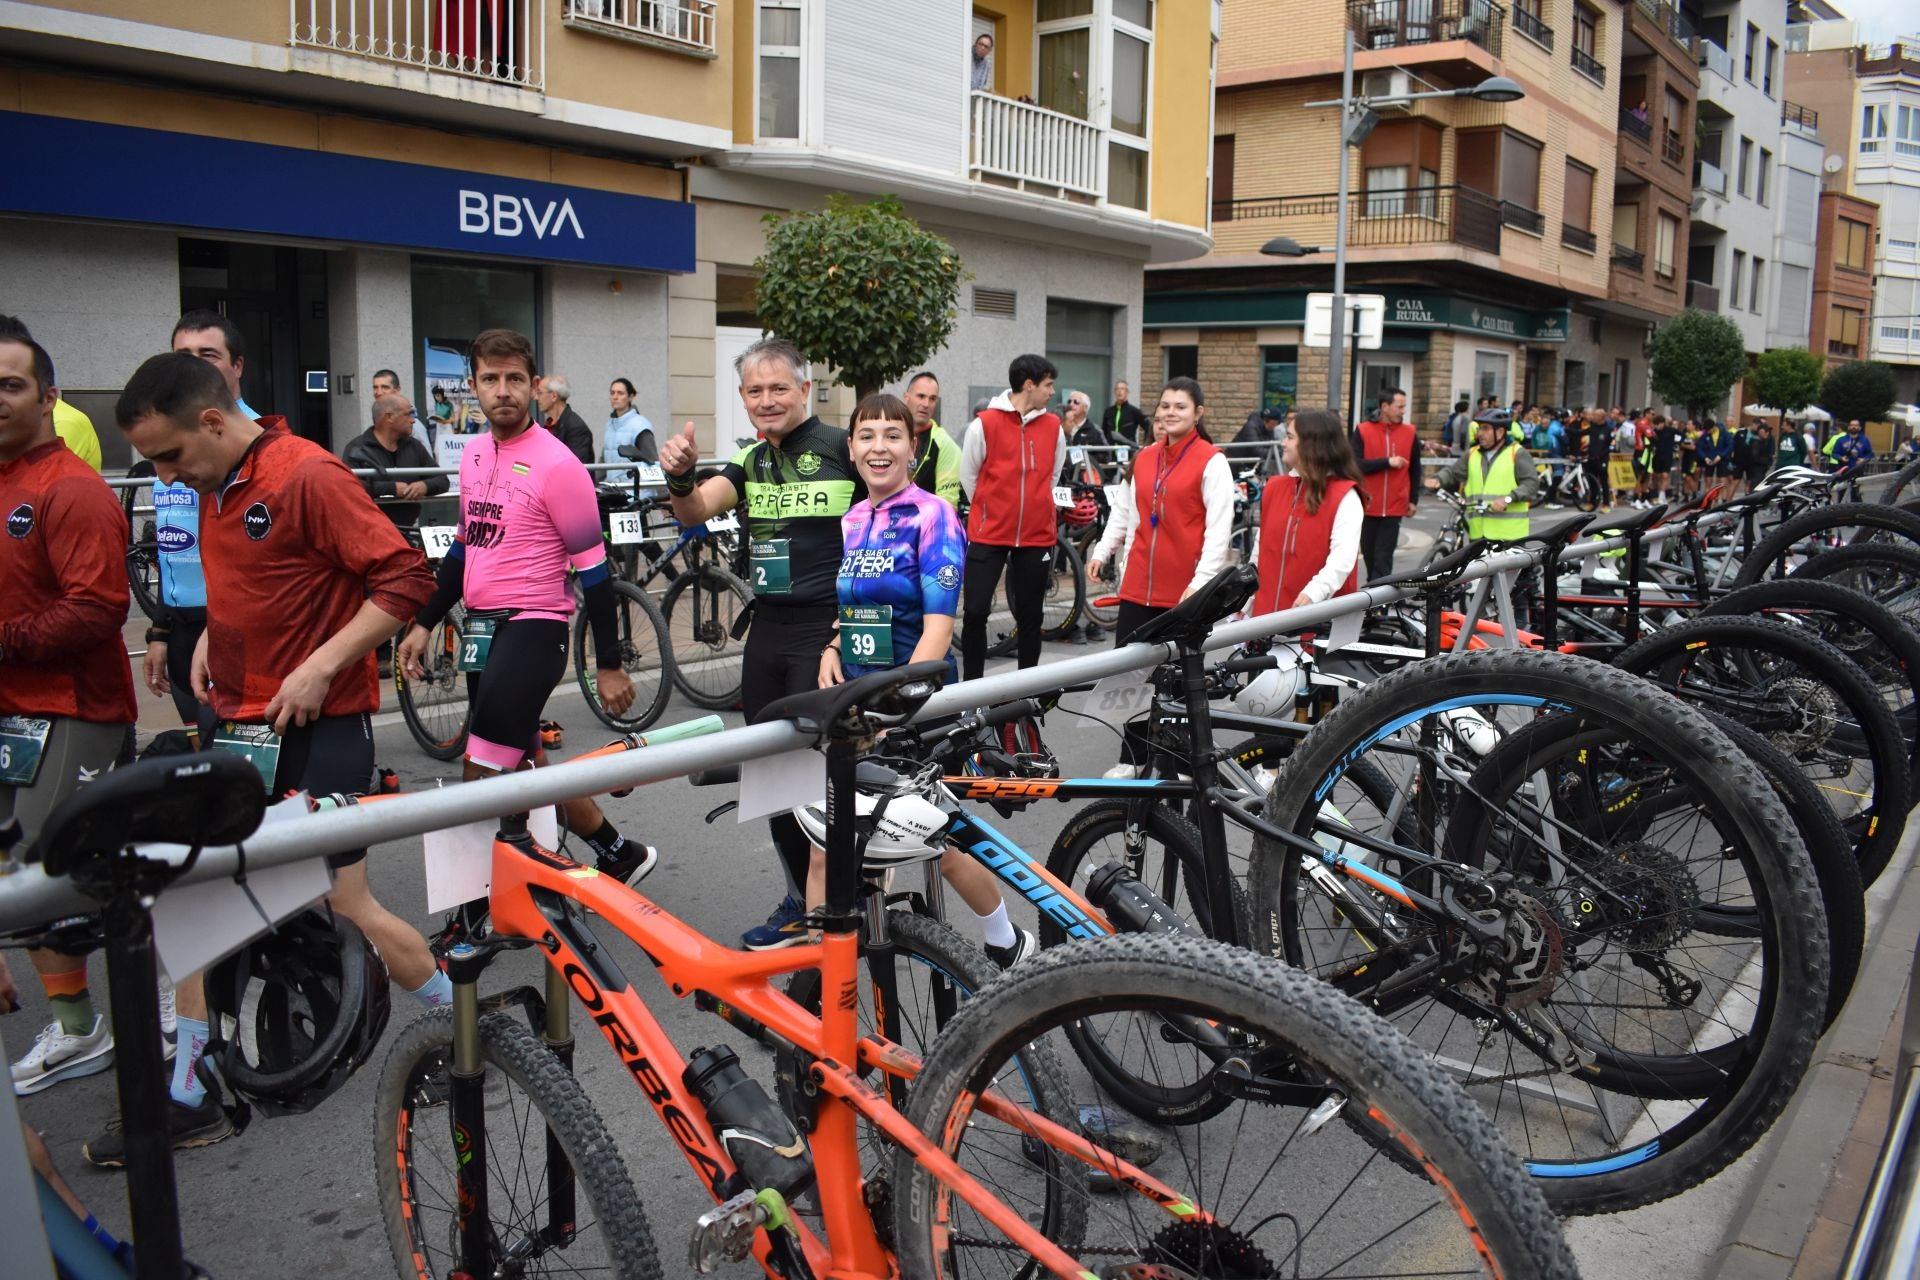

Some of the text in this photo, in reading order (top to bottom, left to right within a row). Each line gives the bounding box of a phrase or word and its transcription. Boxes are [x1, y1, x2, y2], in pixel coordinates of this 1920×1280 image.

[459, 189, 585, 240] BBVA
[1396, 299, 1424, 311] CAJA
[1396, 310, 1435, 322] RURAL
[643, 468, 660, 477] 135
[467, 500, 504, 521] SIEMPRE
[756, 566, 768, 586] 2
[464, 643, 479, 663] 22
[851, 633, 876, 656] 39
[563, 963, 727, 1199] ORBEA
[910, 1066, 964, 1224] CONENTAL
